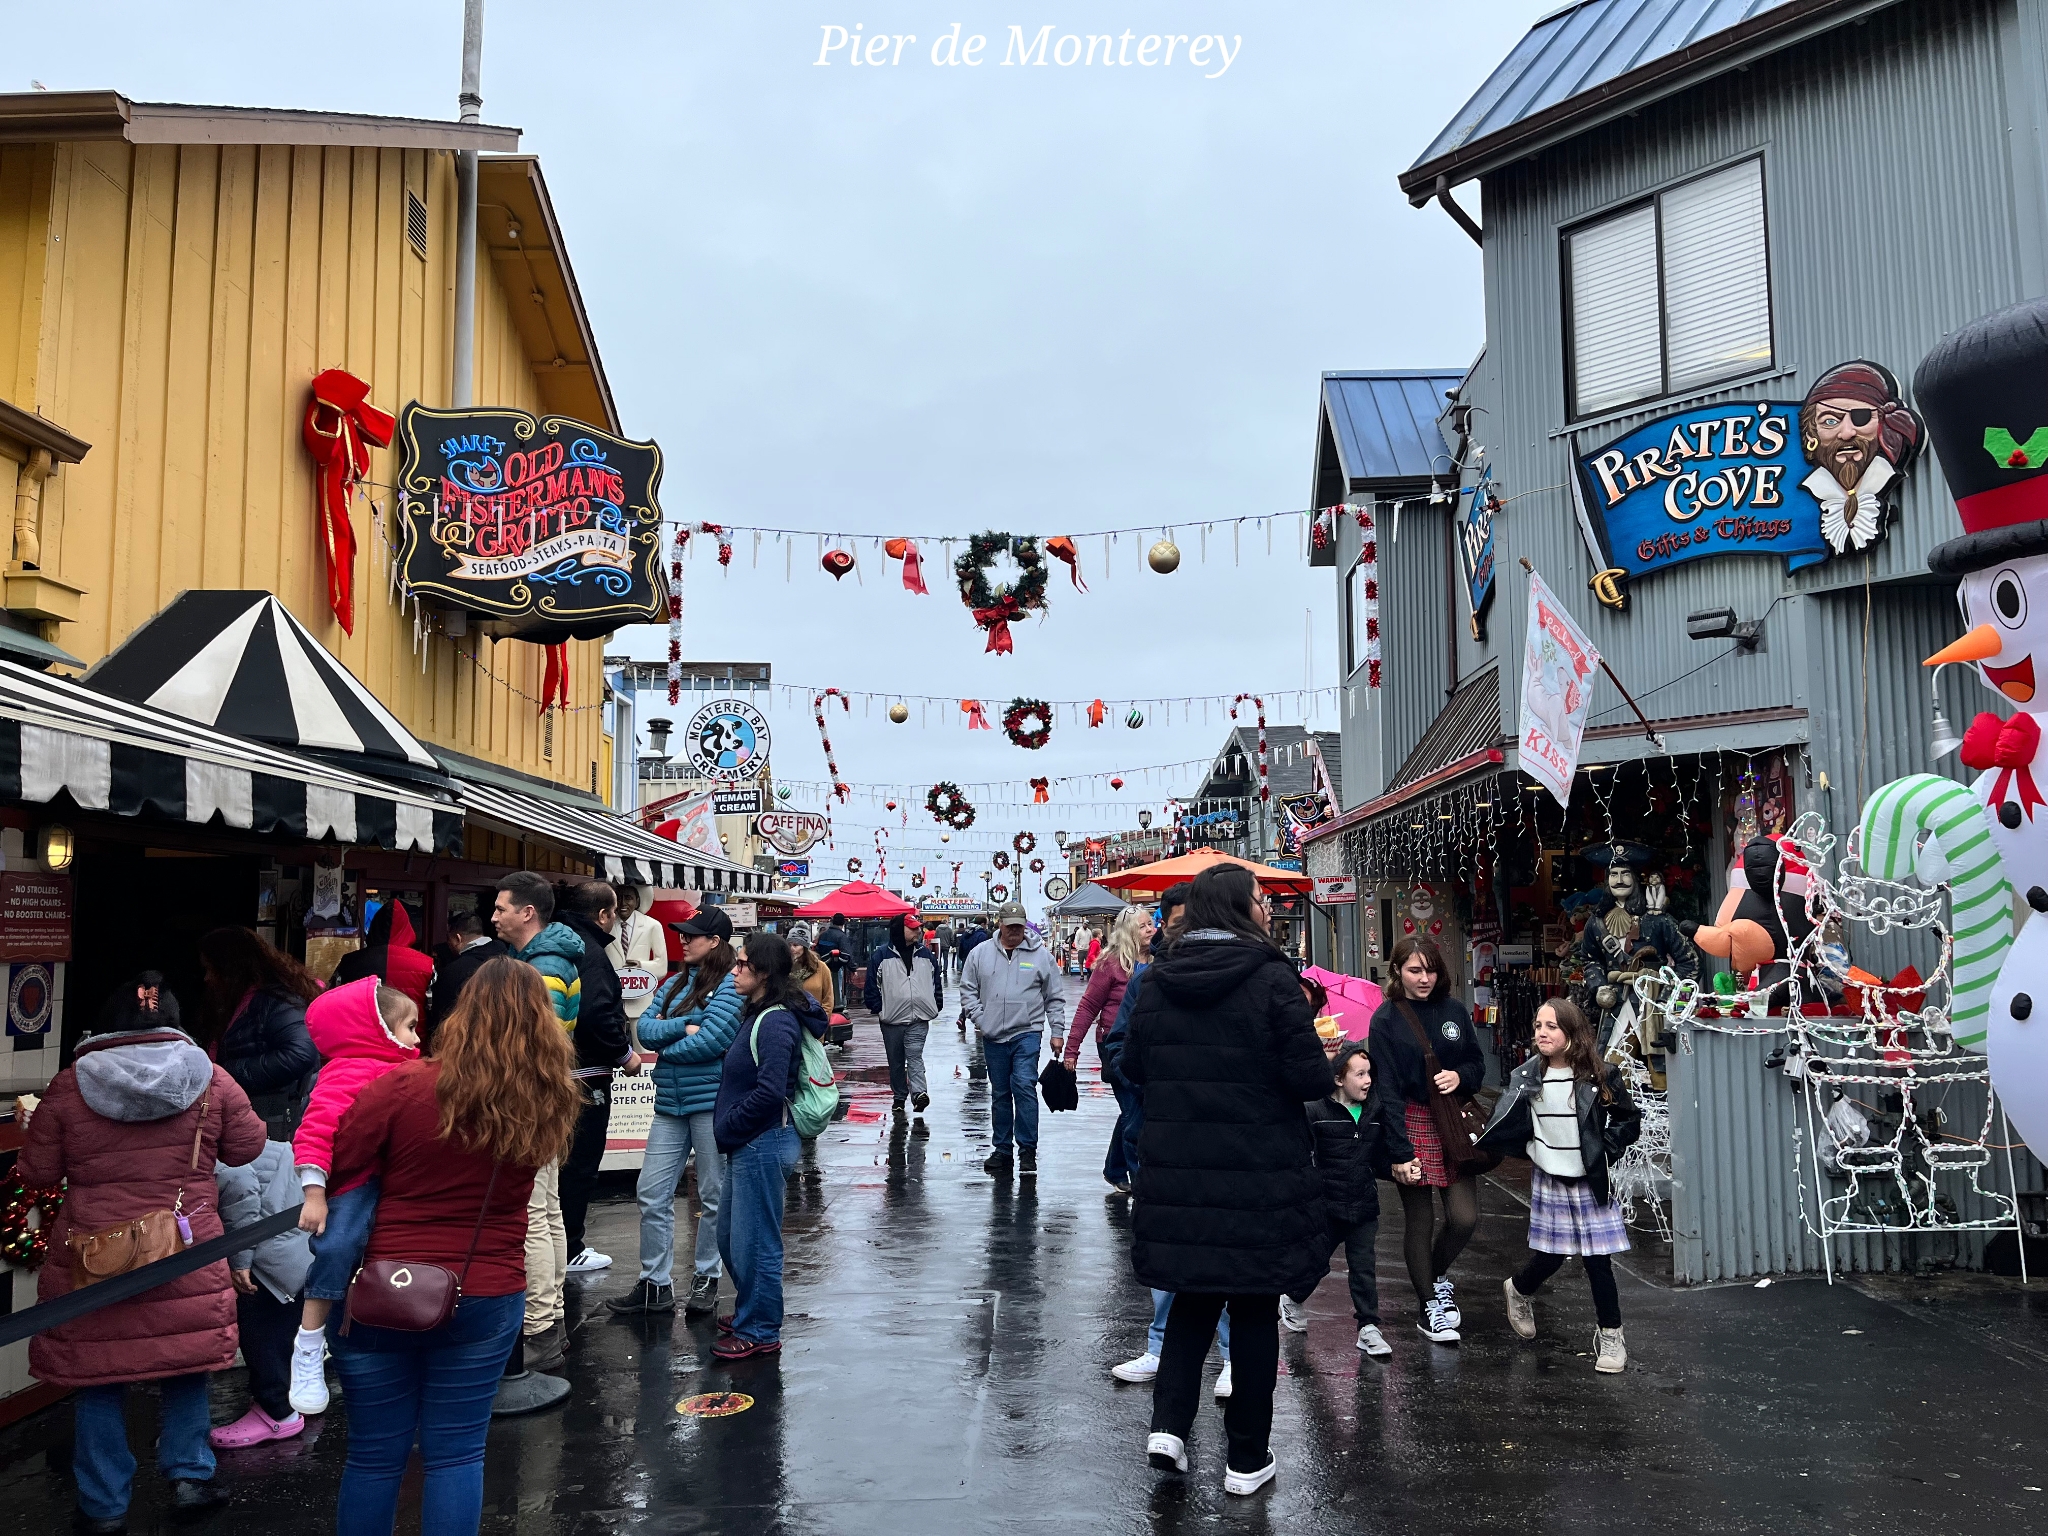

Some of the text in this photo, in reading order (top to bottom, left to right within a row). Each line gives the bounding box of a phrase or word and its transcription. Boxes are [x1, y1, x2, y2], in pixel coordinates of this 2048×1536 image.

[504, 441, 564, 487] OLD
[1591, 403, 1789, 506] PIRATE'S
[440, 467, 625, 525] FISHERMAN'S
[1664, 466, 1785, 520] COVE
[475, 497, 590, 558] GROTTO
[1637, 515, 1793, 561] Gifts & Things
[689, 703, 767, 741] MONTEREY BAY
[693, 752, 763, 780] CREAMERY
[1525, 727, 1568, 778] KISS
[714, 793, 756, 802] MEMADE
[720, 803, 755, 811] CREAM
[760, 815, 824, 835] CAFE FINA
[1268, 861, 1296, 869] Chris'
[10, 898, 61, 907] NO HIGH CHAIRS
[15, 885, 58, 894] NO STROLLERS
[4, 910, 66, 919] NO BOOSTER CHAIRS
[620, 977, 649, 989] PEN
